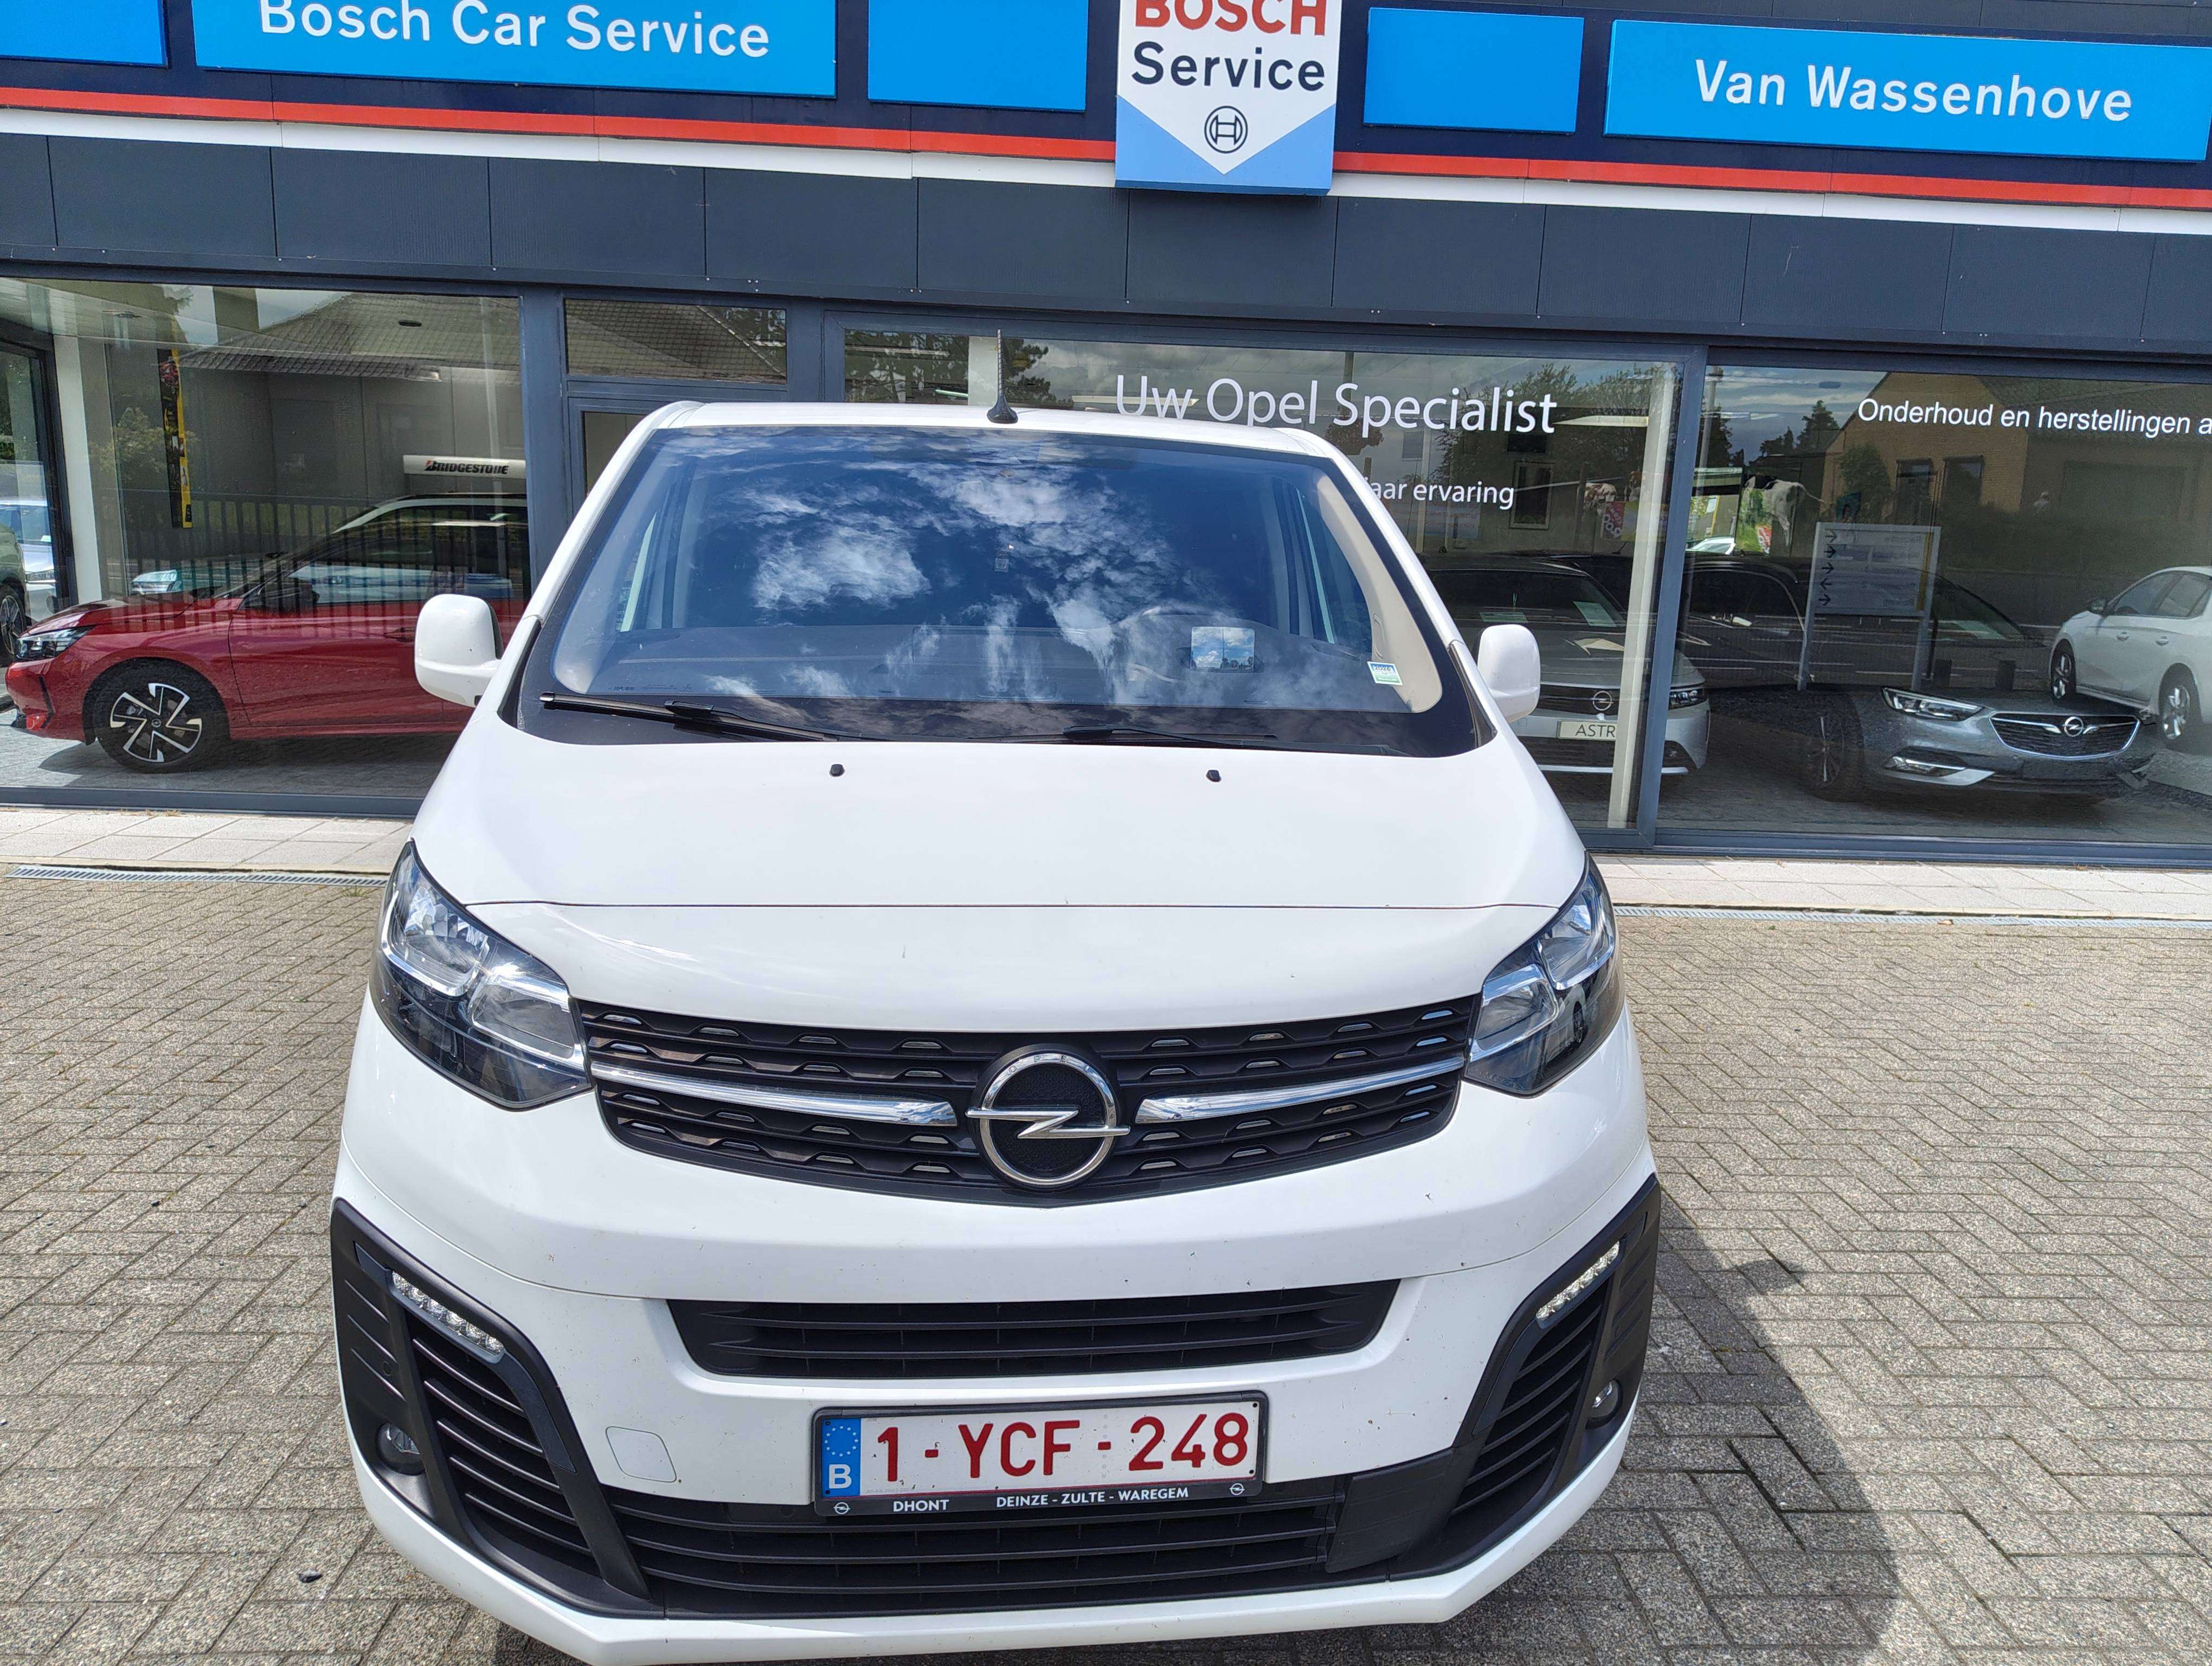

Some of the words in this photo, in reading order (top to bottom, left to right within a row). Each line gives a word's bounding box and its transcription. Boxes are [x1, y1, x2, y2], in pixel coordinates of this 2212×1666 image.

[260, 0, 430, 41] Bosch
[452, 0, 546, 47] Car
[565, 4, 769, 57] Service
[1135, 0, 1327, 36] BOSCH
[1131, 41, 1326, 92] Service
[1695, 59, 1785, 106] Van
[1807, 64, 2132, 121] Wassenhove
[1116, 375, 1193, 419] Uw
[1206, 378, 1318, 427] Opel
[1333, 383, 1558, 438] Specialist
[1857, 398, 1994, 426] Onderhoud
[2001, 409, 2030, 428] en
[2039, 406, 2190, 439] herstellingen
[425, 460, 509, 475] BRIDGESTONE
[1363, 476, 1407, 500] aar
[1413, 480, 1514, 510] ervaring
[828, 1464, 852, 1489] B
[893, 1499, 950, 1513] DHONT
[996, 1494, 1049, 1508] DEINZE
[1060, 1491, 1105, 1505] ZULTE
[1117, 1486, 1189, 1502] WAREGEM
